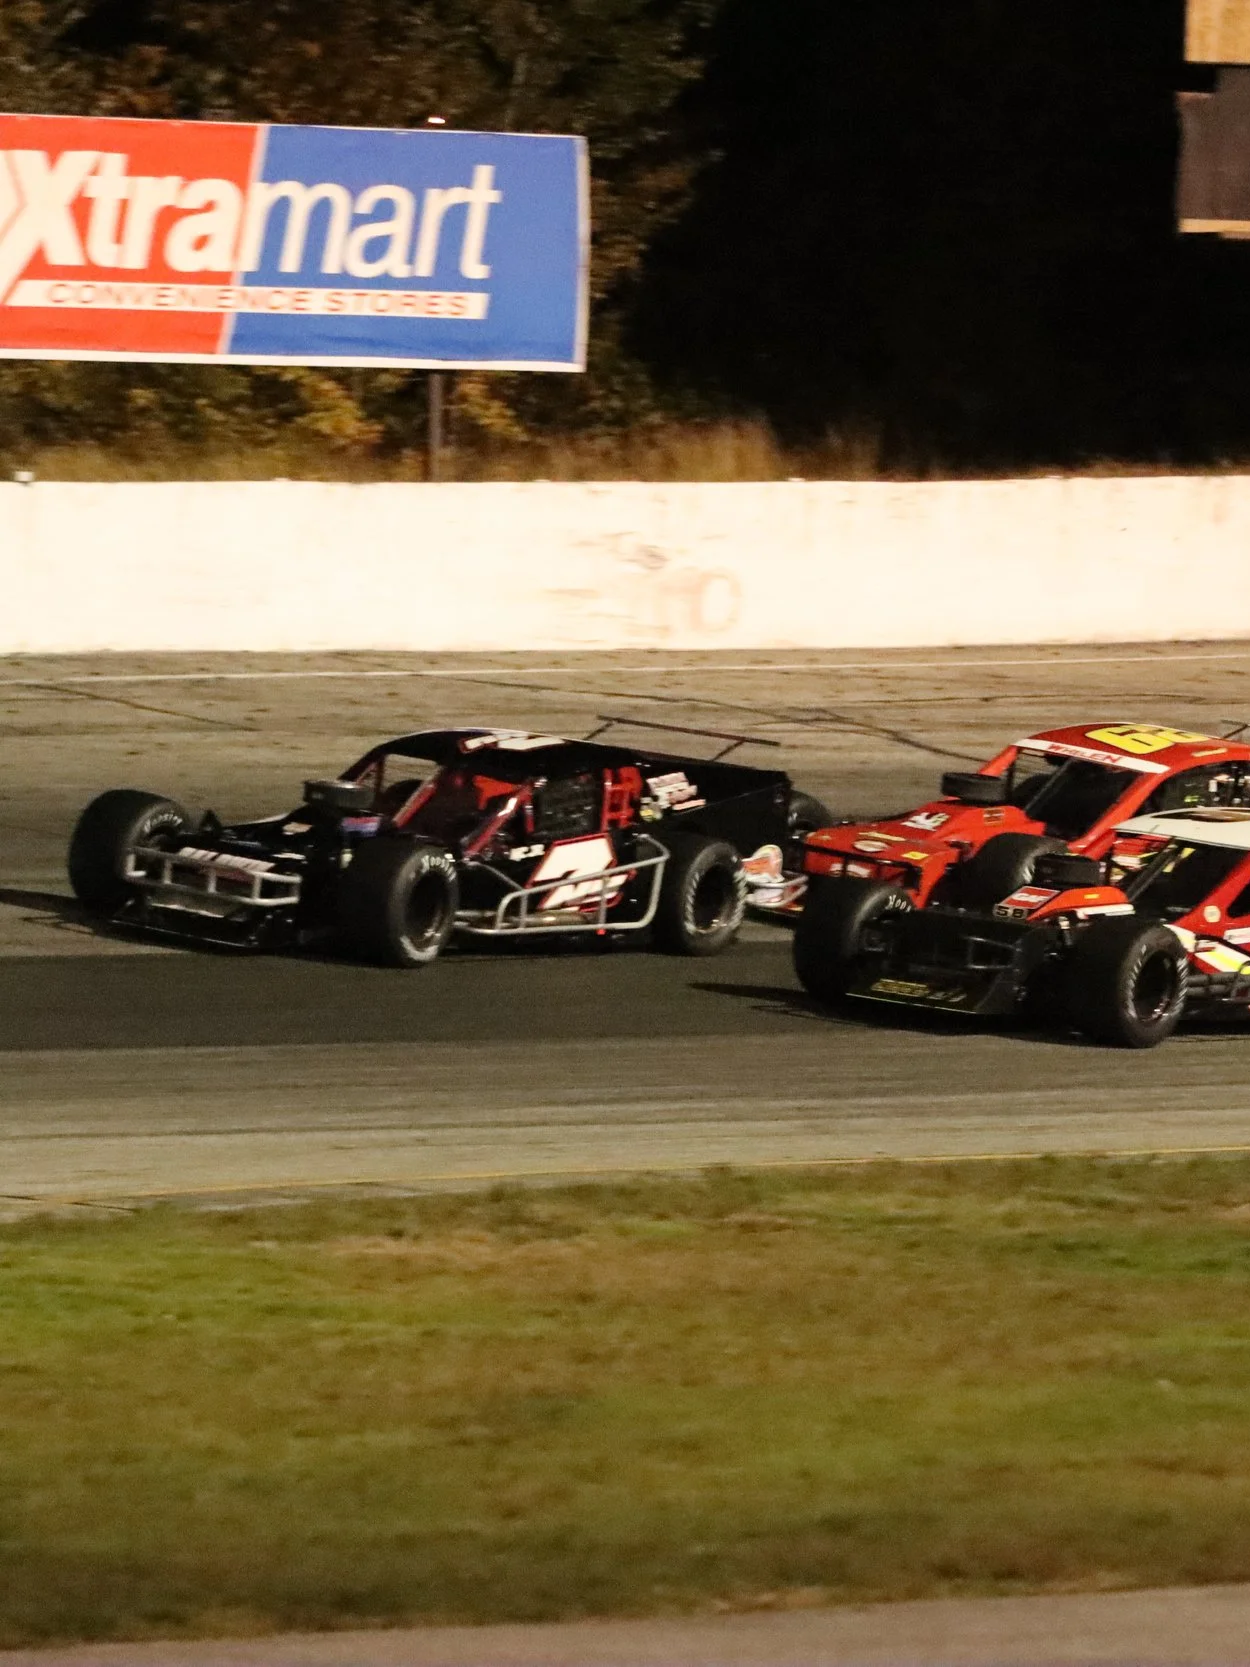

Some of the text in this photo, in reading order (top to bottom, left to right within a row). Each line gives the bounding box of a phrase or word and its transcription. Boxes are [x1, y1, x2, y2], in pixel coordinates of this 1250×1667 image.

[48, 283, 469, 317] CONVENIENCE STORES
[996, 905, 1025, 918] 58
